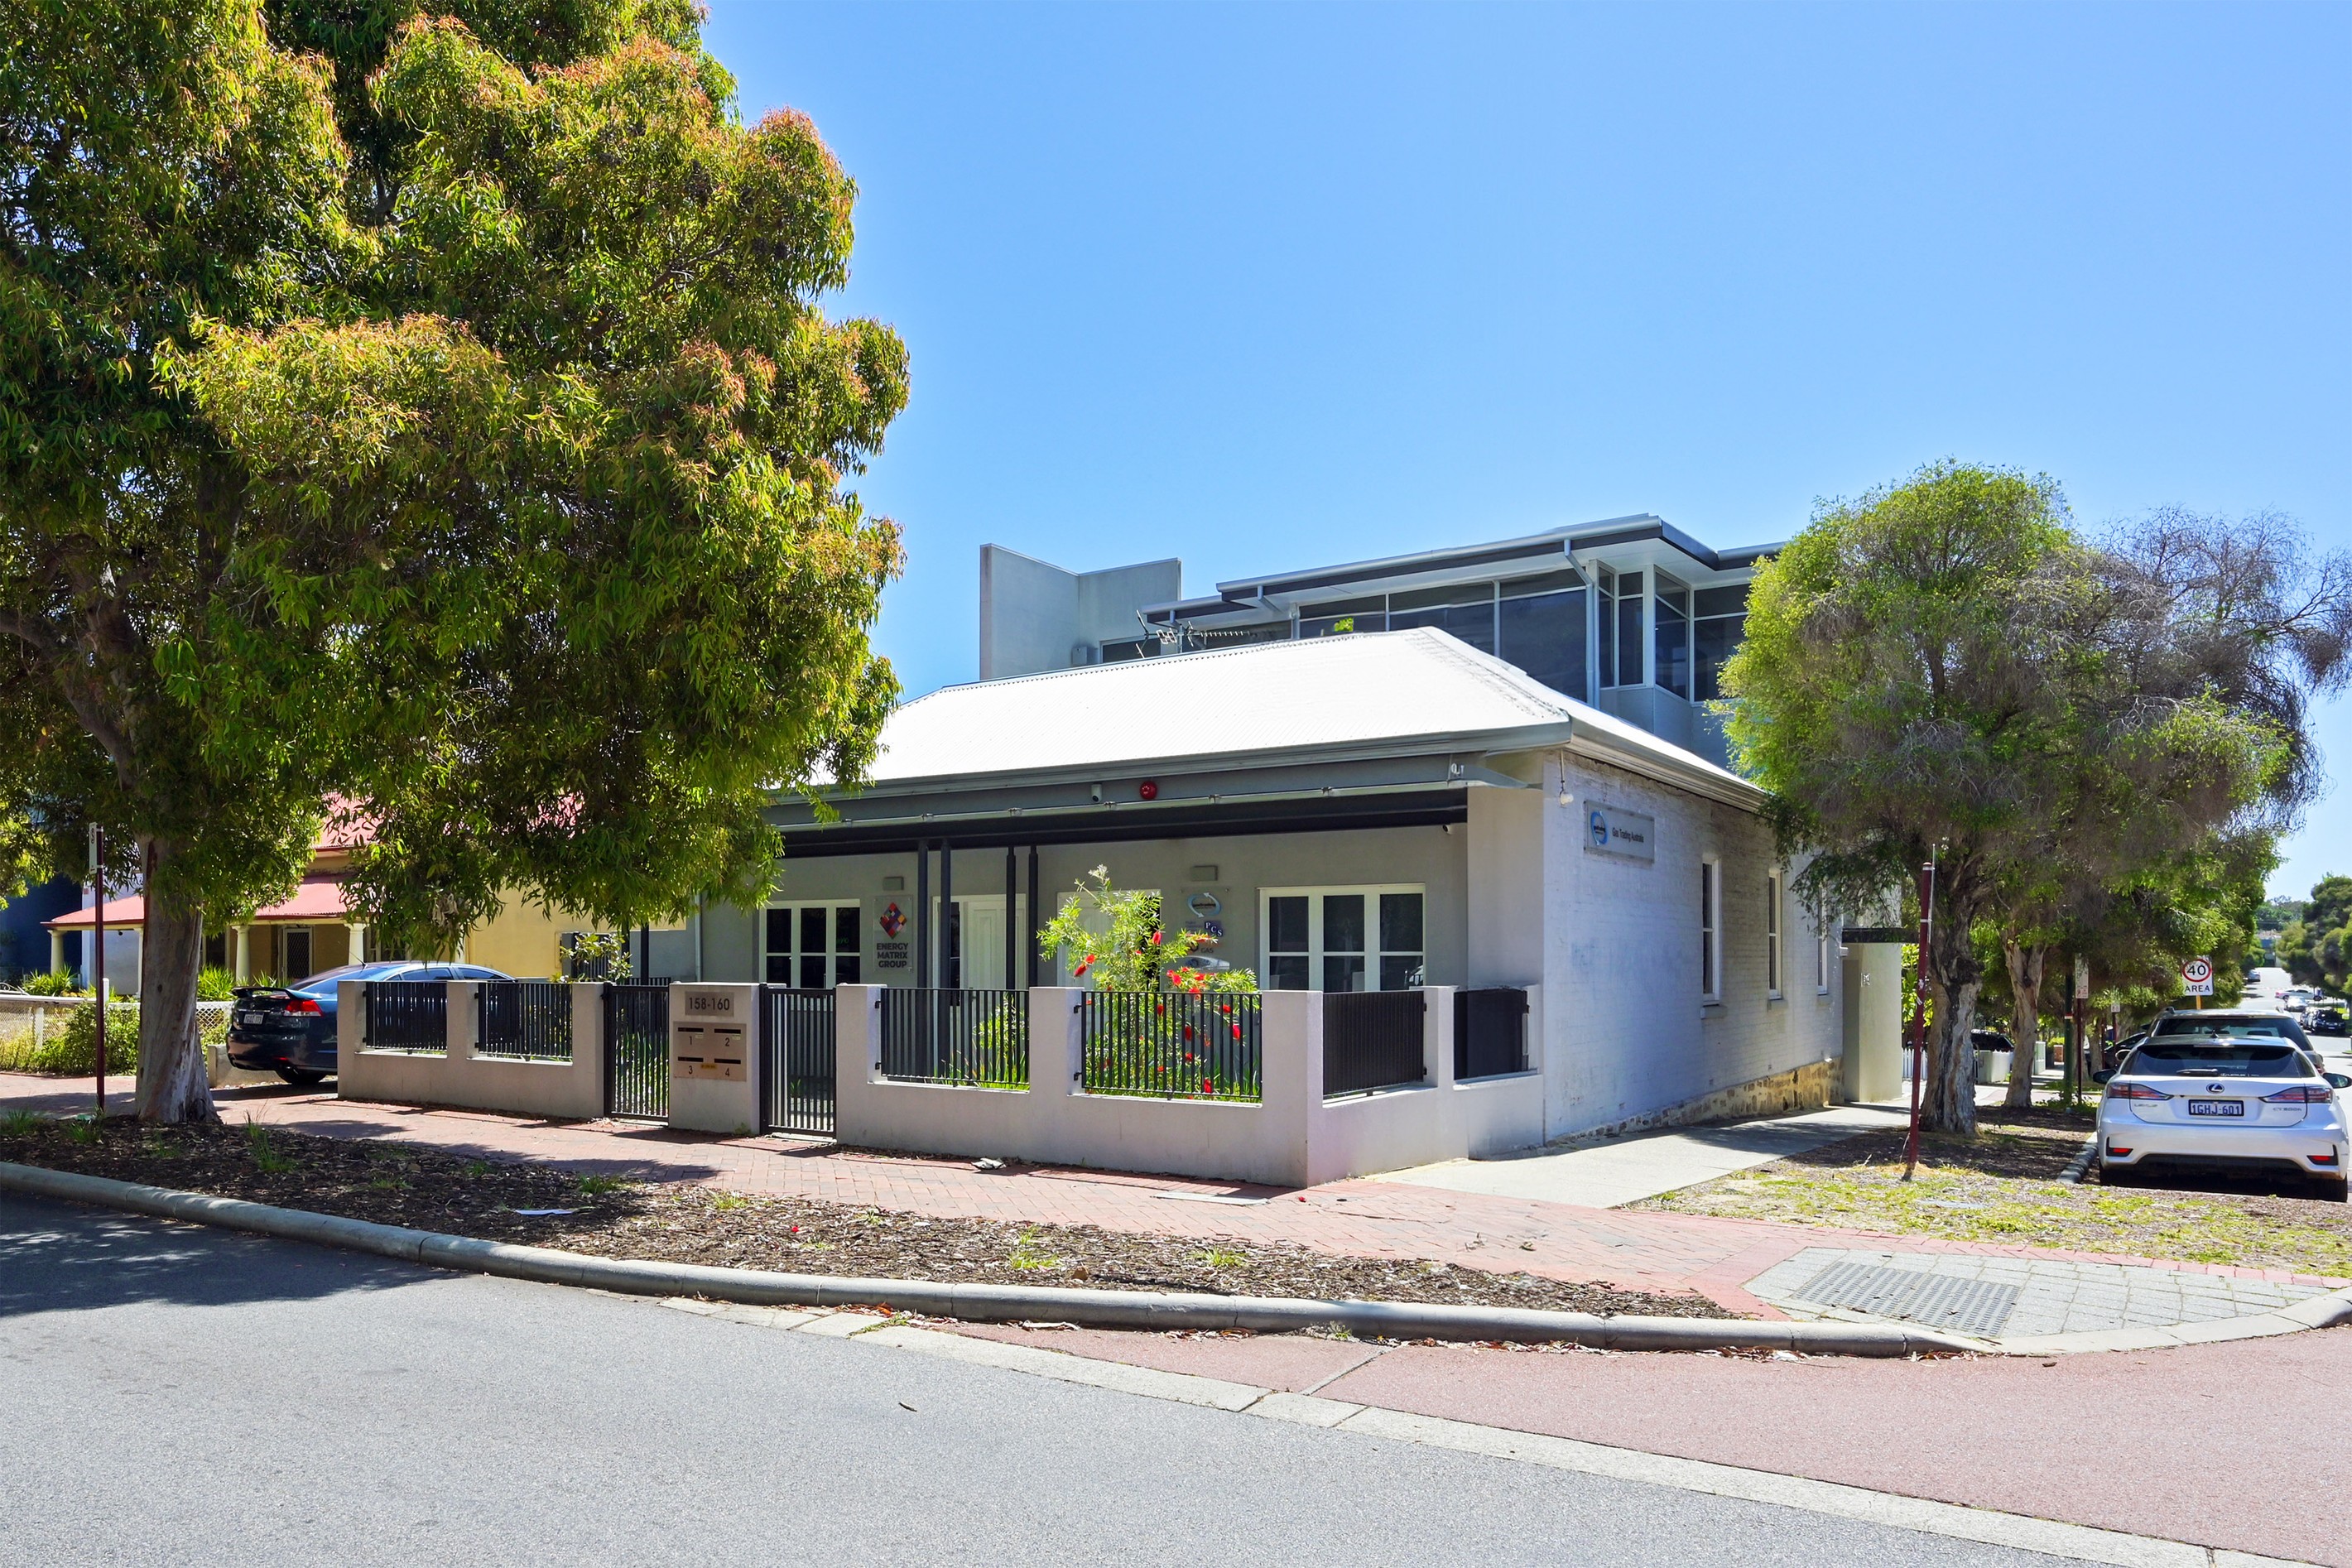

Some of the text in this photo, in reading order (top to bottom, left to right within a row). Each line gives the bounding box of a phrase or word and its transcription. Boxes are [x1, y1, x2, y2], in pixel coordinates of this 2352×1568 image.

[1619, 829, 1631, 843] Trading
[878, 951, 908, 960] MATRIX
[878, 960, 907, 969] GROUP
[2186, 964, 2206, 976] 40
[689, 997, 730, 1011] 158-160
[724, 1037, 730, 1047] 2
[688, 1065, 693, 1075] 3
[724, 1067, 730, 1077] 4
